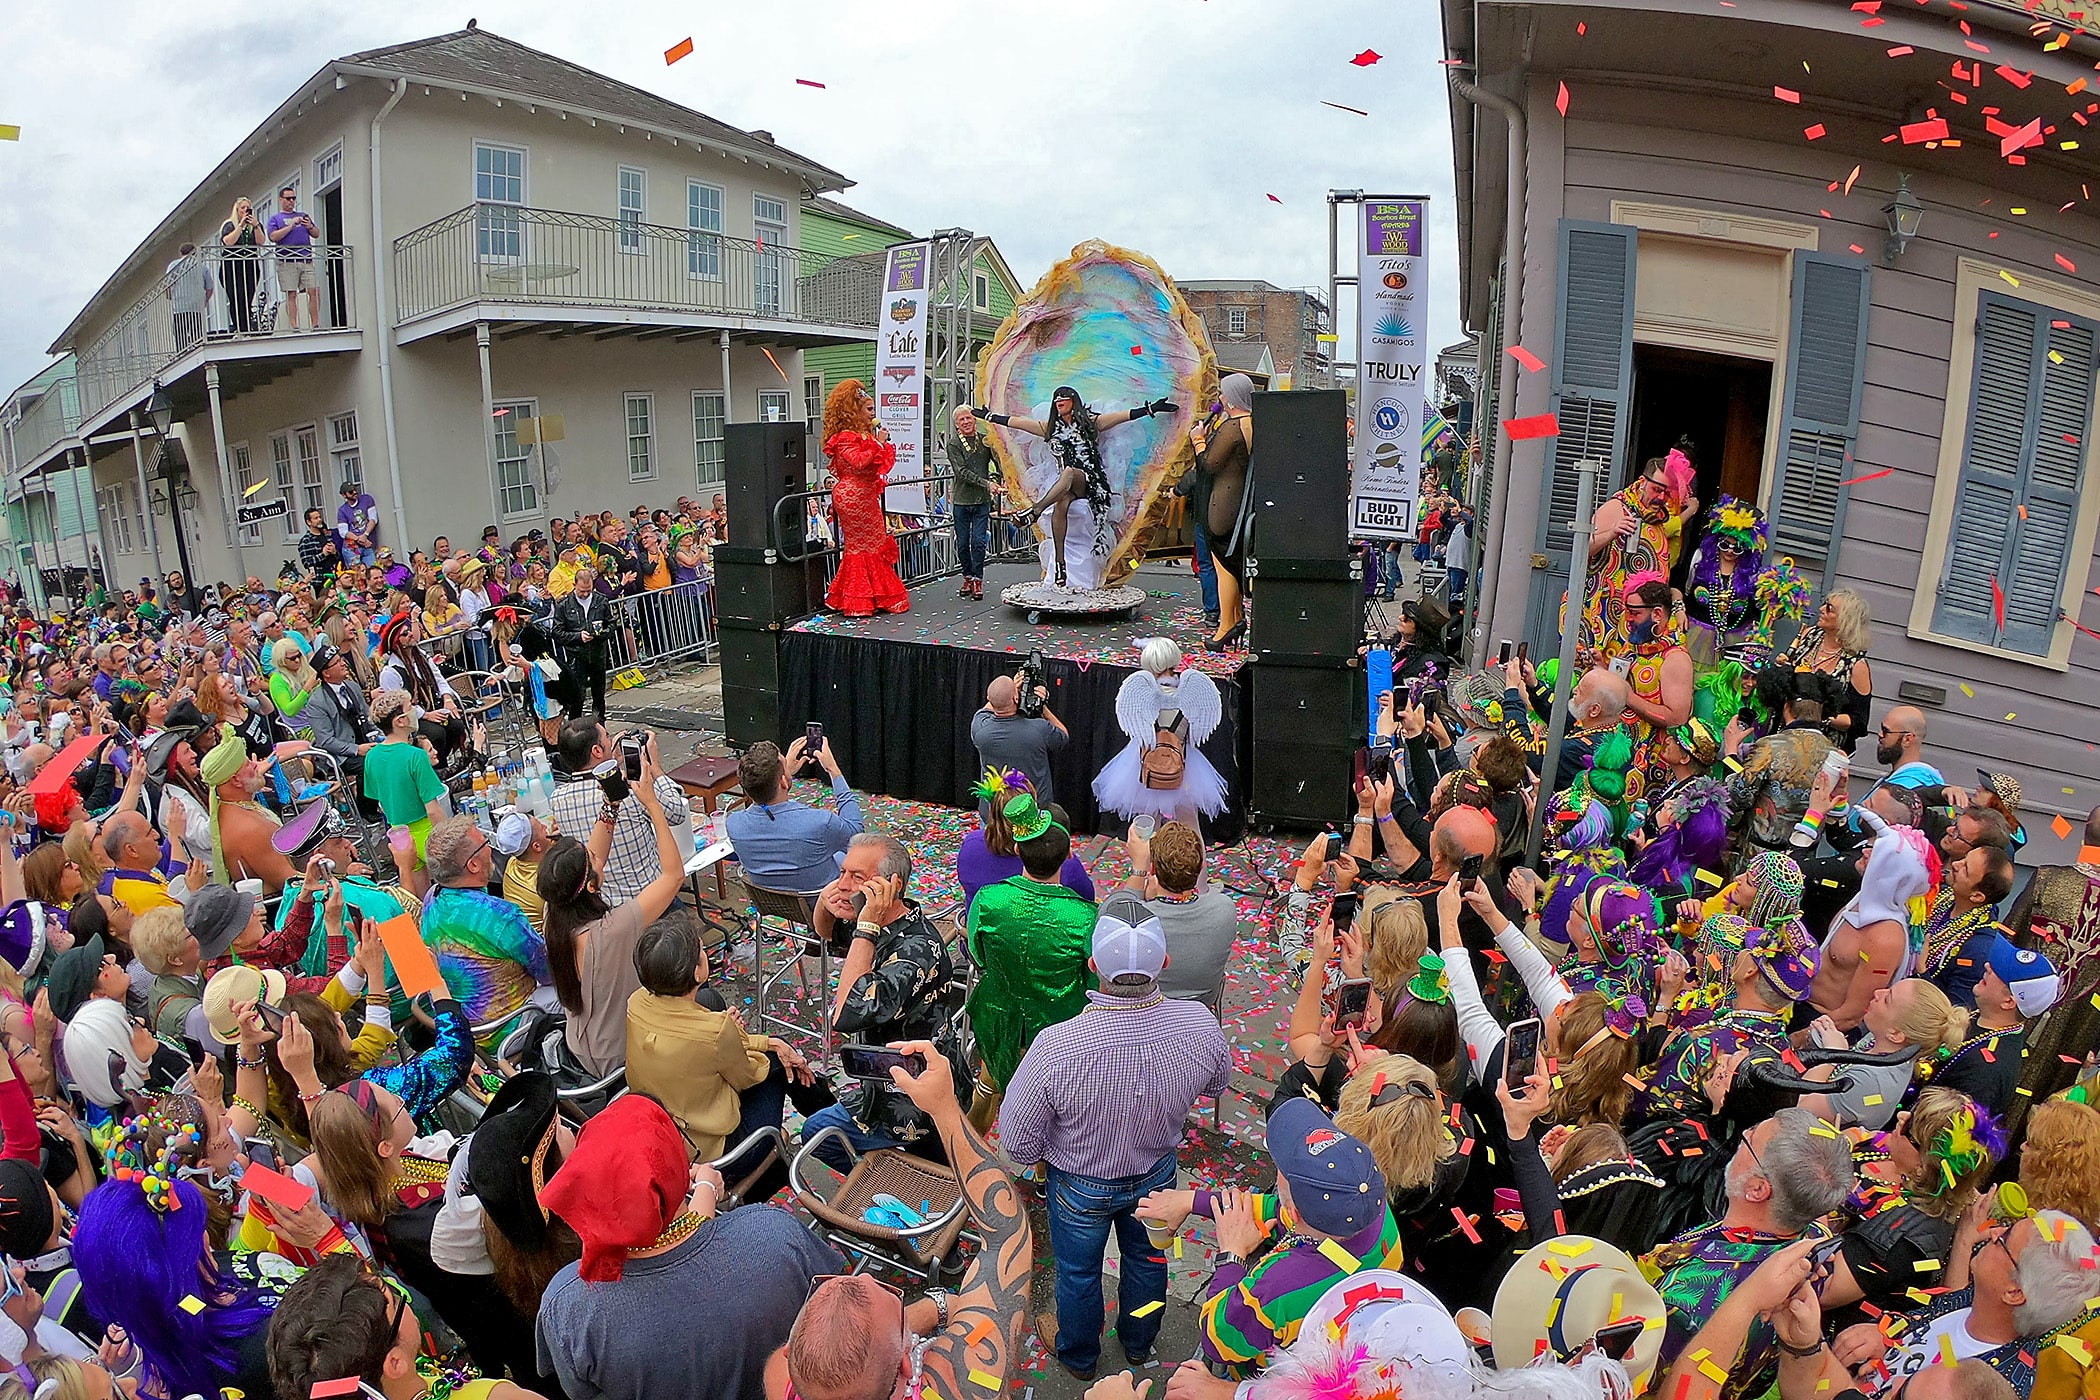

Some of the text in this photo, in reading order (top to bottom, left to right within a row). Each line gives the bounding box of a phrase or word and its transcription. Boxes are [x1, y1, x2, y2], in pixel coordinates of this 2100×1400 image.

[1376, 204, 1411, 214] BSA
[1379, 260, 1411, 270] Tito's
[1375, 290, 1414, 300] Handmade
[1372, 338, 1414, 346] CASAMIGOS
[1365, 362, 1421, 380] TRULY
[1371, 423, 1406, 438] WHITNEY
[1361, 474, 1383, 483] Home
[243, 506, 281, 520] St. Ann
[1368, 503, 1398, 514] BUD
[1361, 513, 1403, 526] LIGHT
